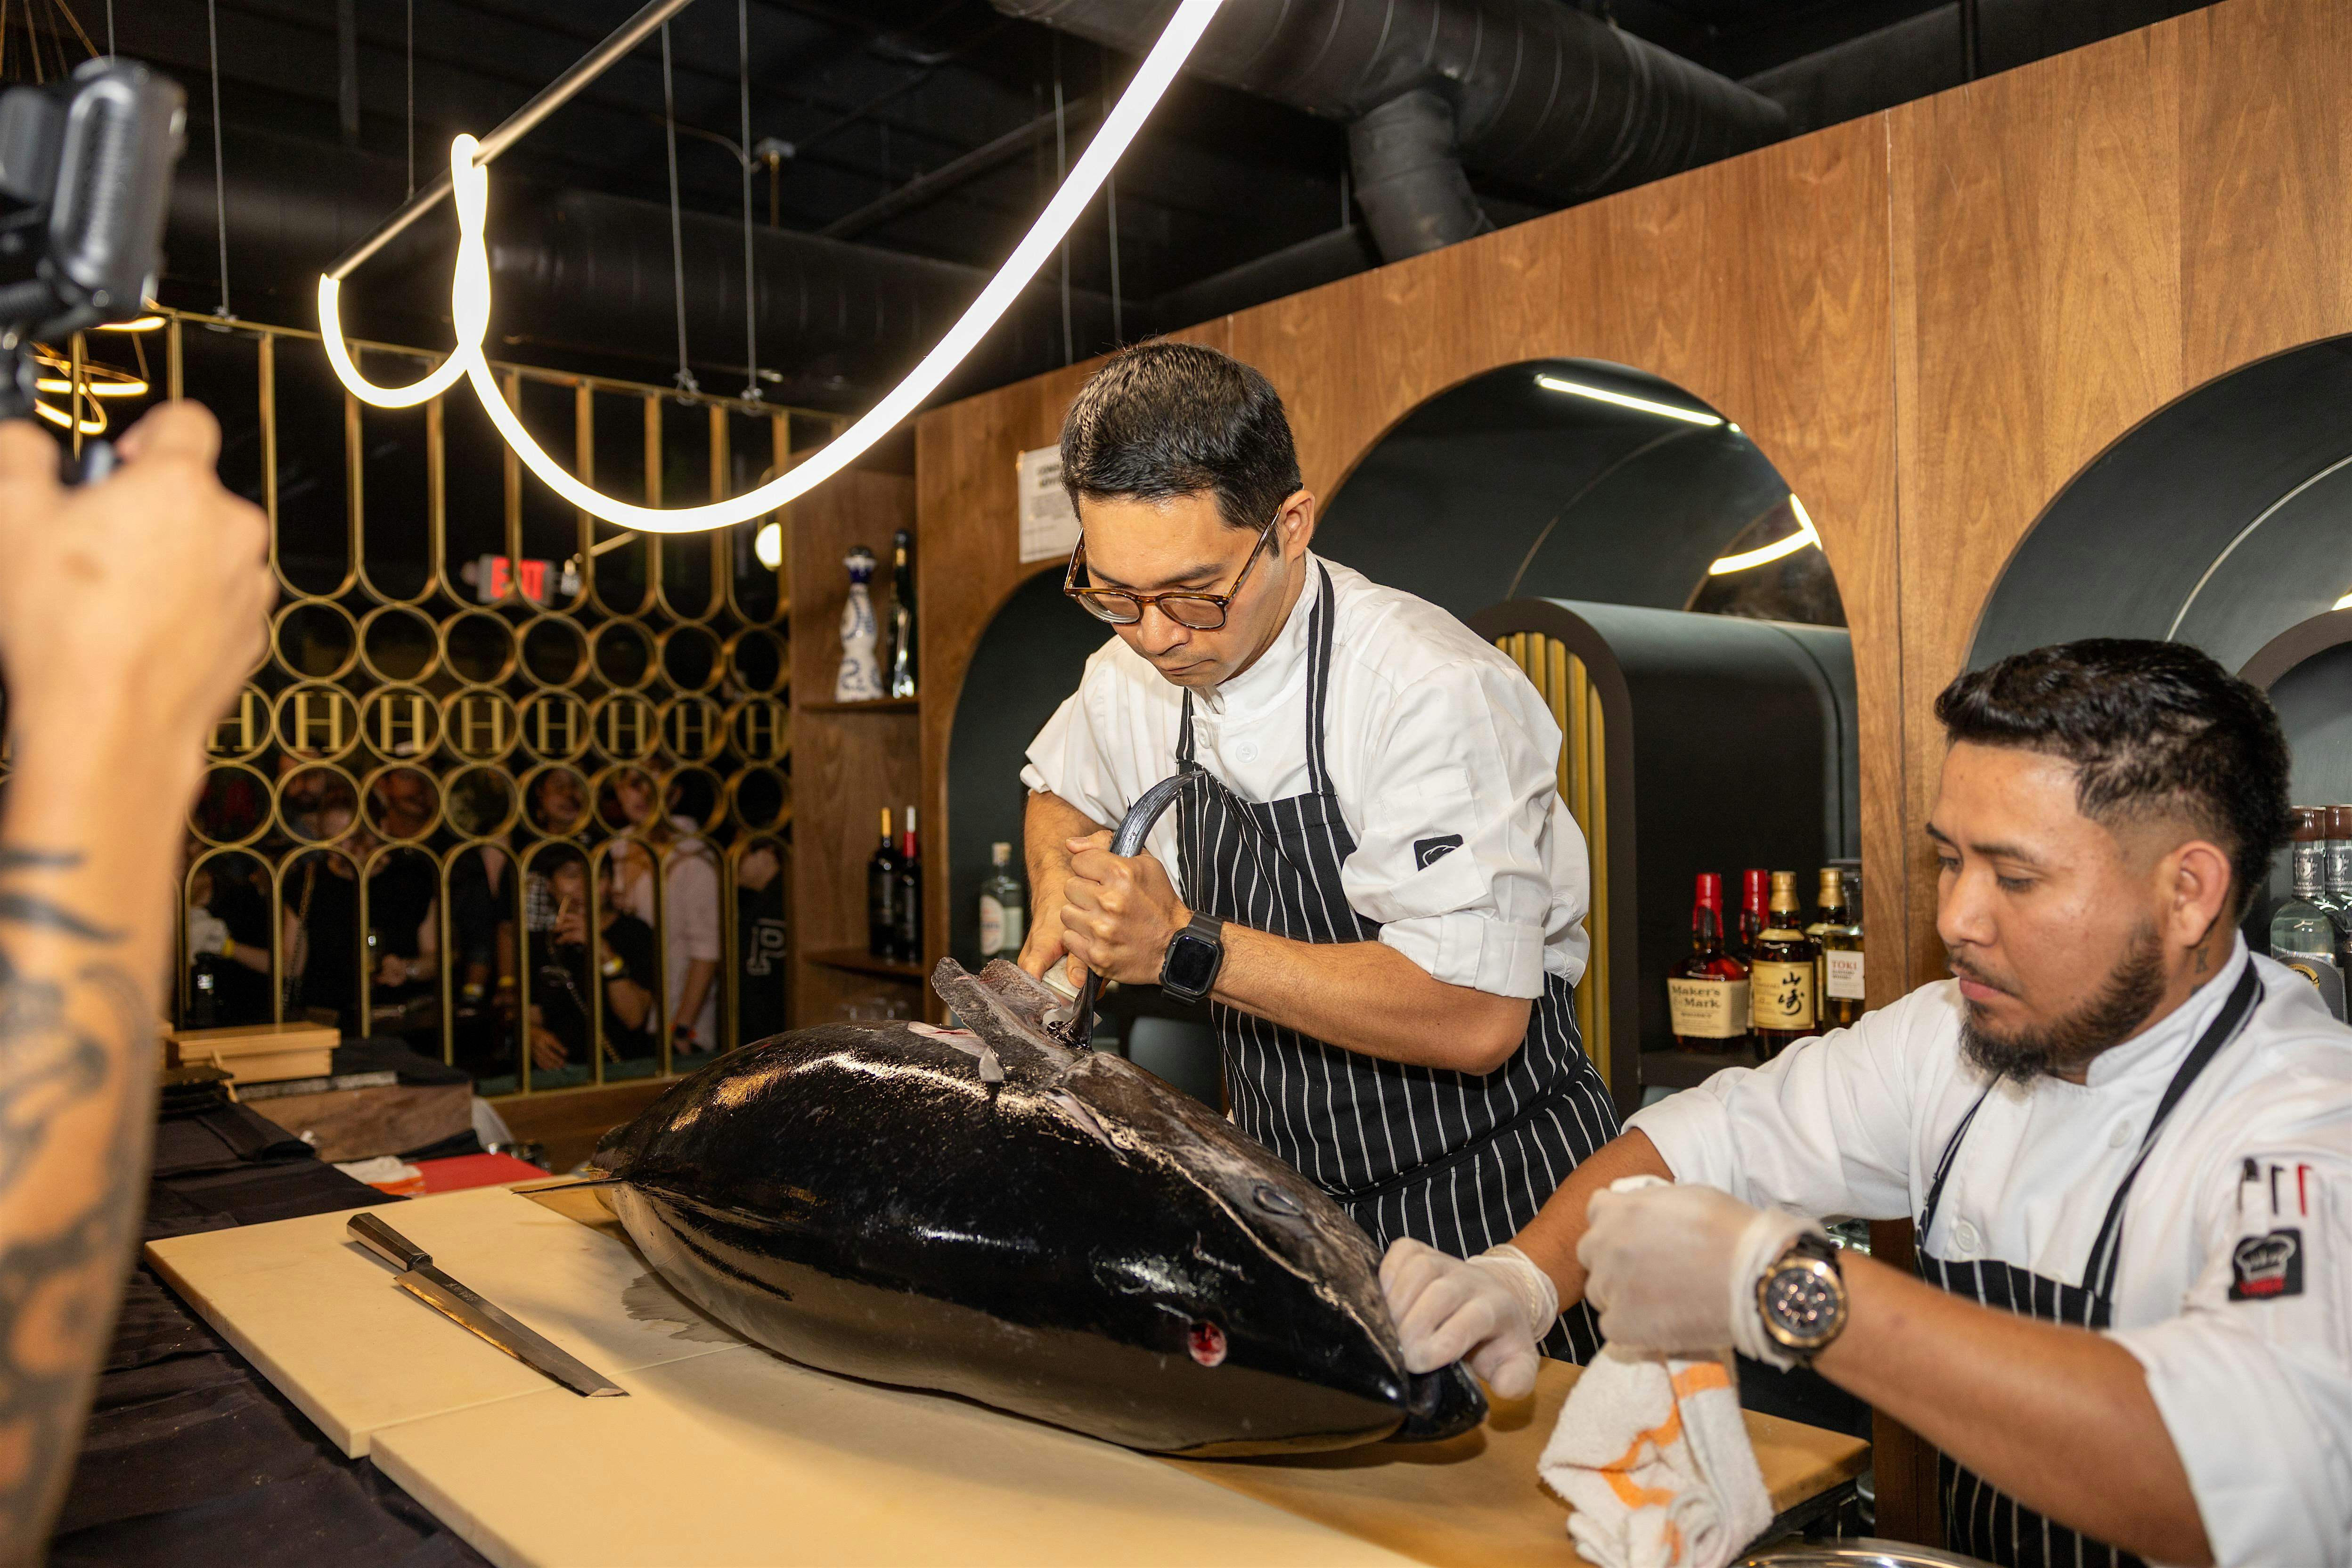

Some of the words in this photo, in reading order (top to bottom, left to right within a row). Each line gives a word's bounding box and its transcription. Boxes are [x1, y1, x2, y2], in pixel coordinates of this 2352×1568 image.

[491, 557, 546, 601] EIT
[1831, 960, 1857, 970] TOKI
[1672, 984, 1721, 996] Maker's
[1778, 972, 1805, 1016] 山崎
